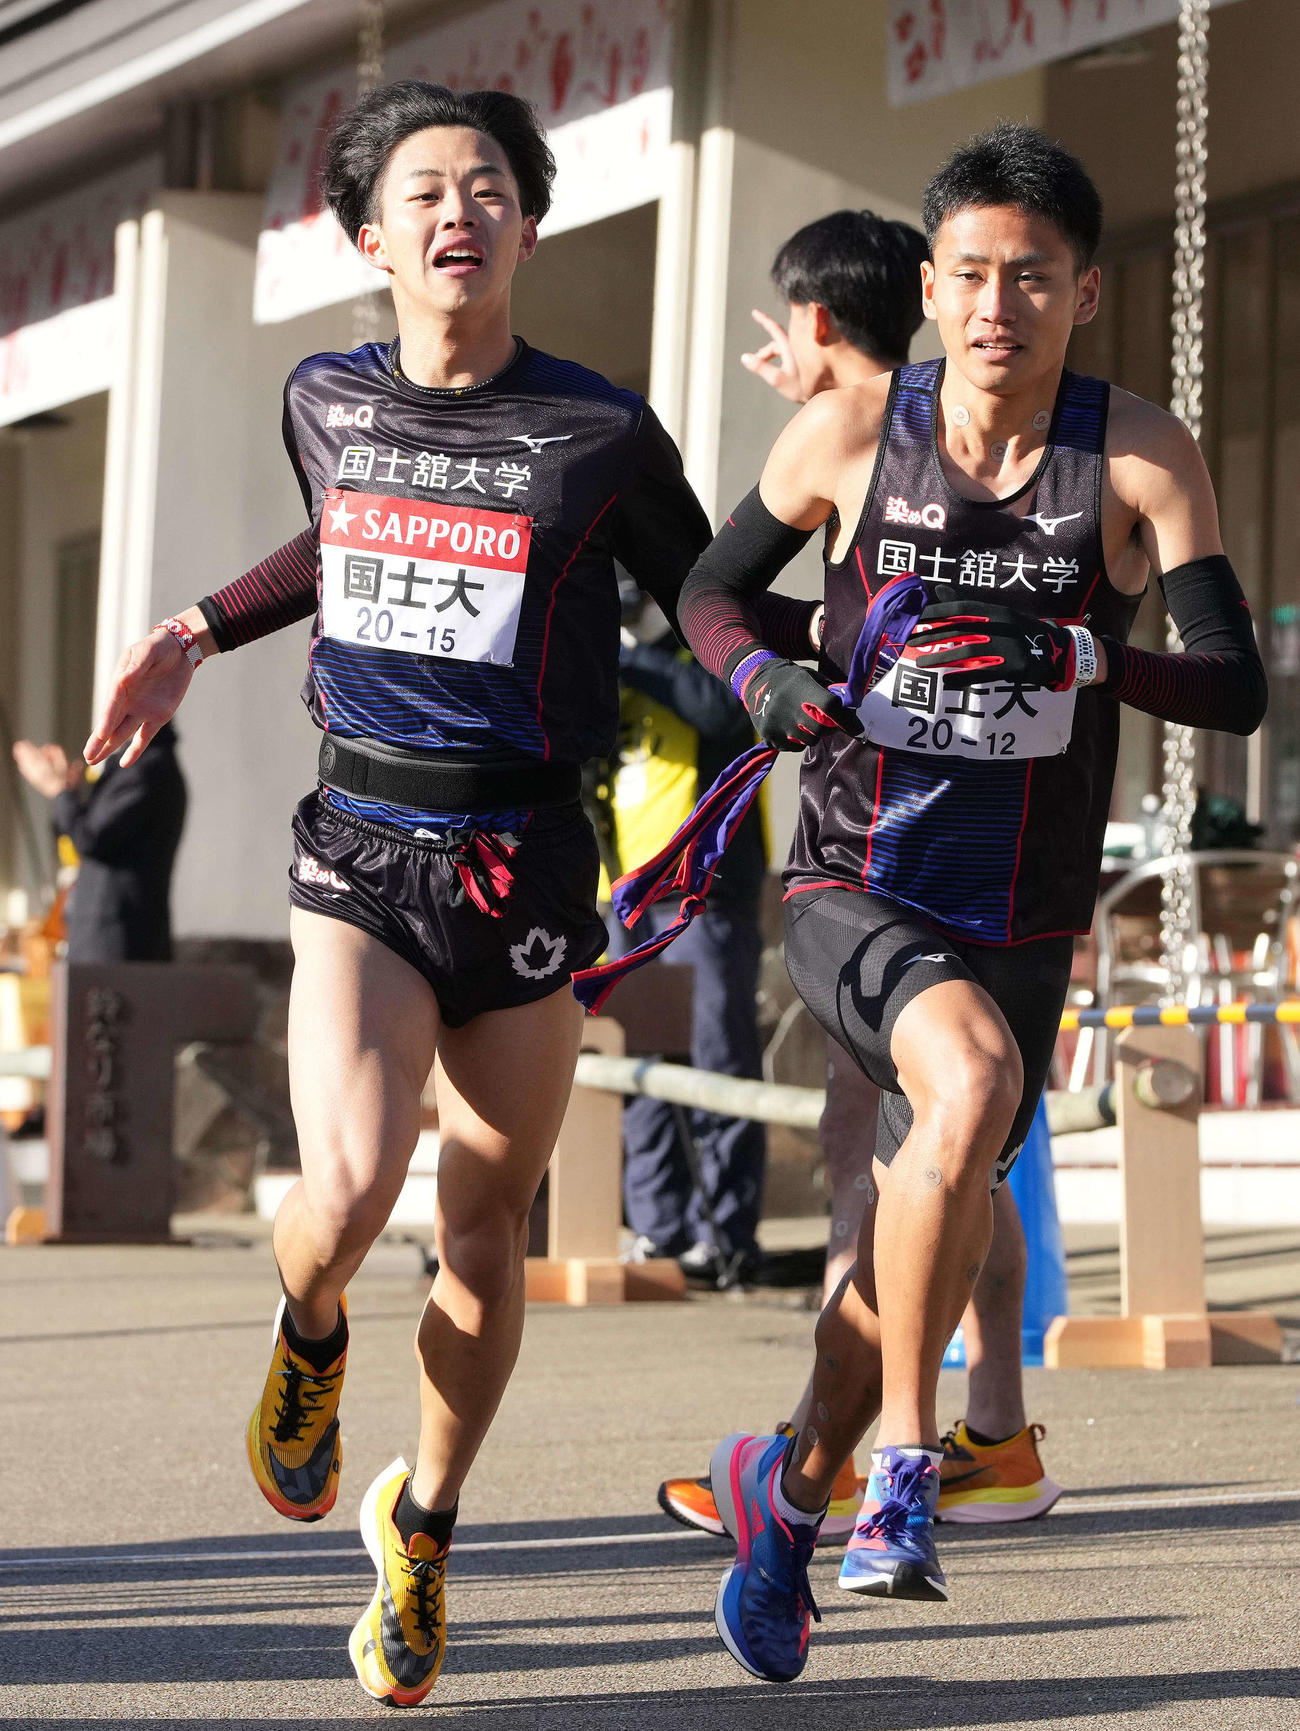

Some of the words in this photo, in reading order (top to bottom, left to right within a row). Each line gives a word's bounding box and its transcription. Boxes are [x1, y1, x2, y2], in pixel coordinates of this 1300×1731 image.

[326, 405, 373, 429] 染めQ
[337, 445, 532, 498] 国士舘大学
[361, 508, 522, 560] SAPPORO
[885, 496, 946, 529] 染めQ
[343, 553, 485, 618] 国士大
[876, 539, 1079, 593] 国士舘大学
[356, 606, 457, 653] 20-15
[906, 715, 1017, 756] 20-12
